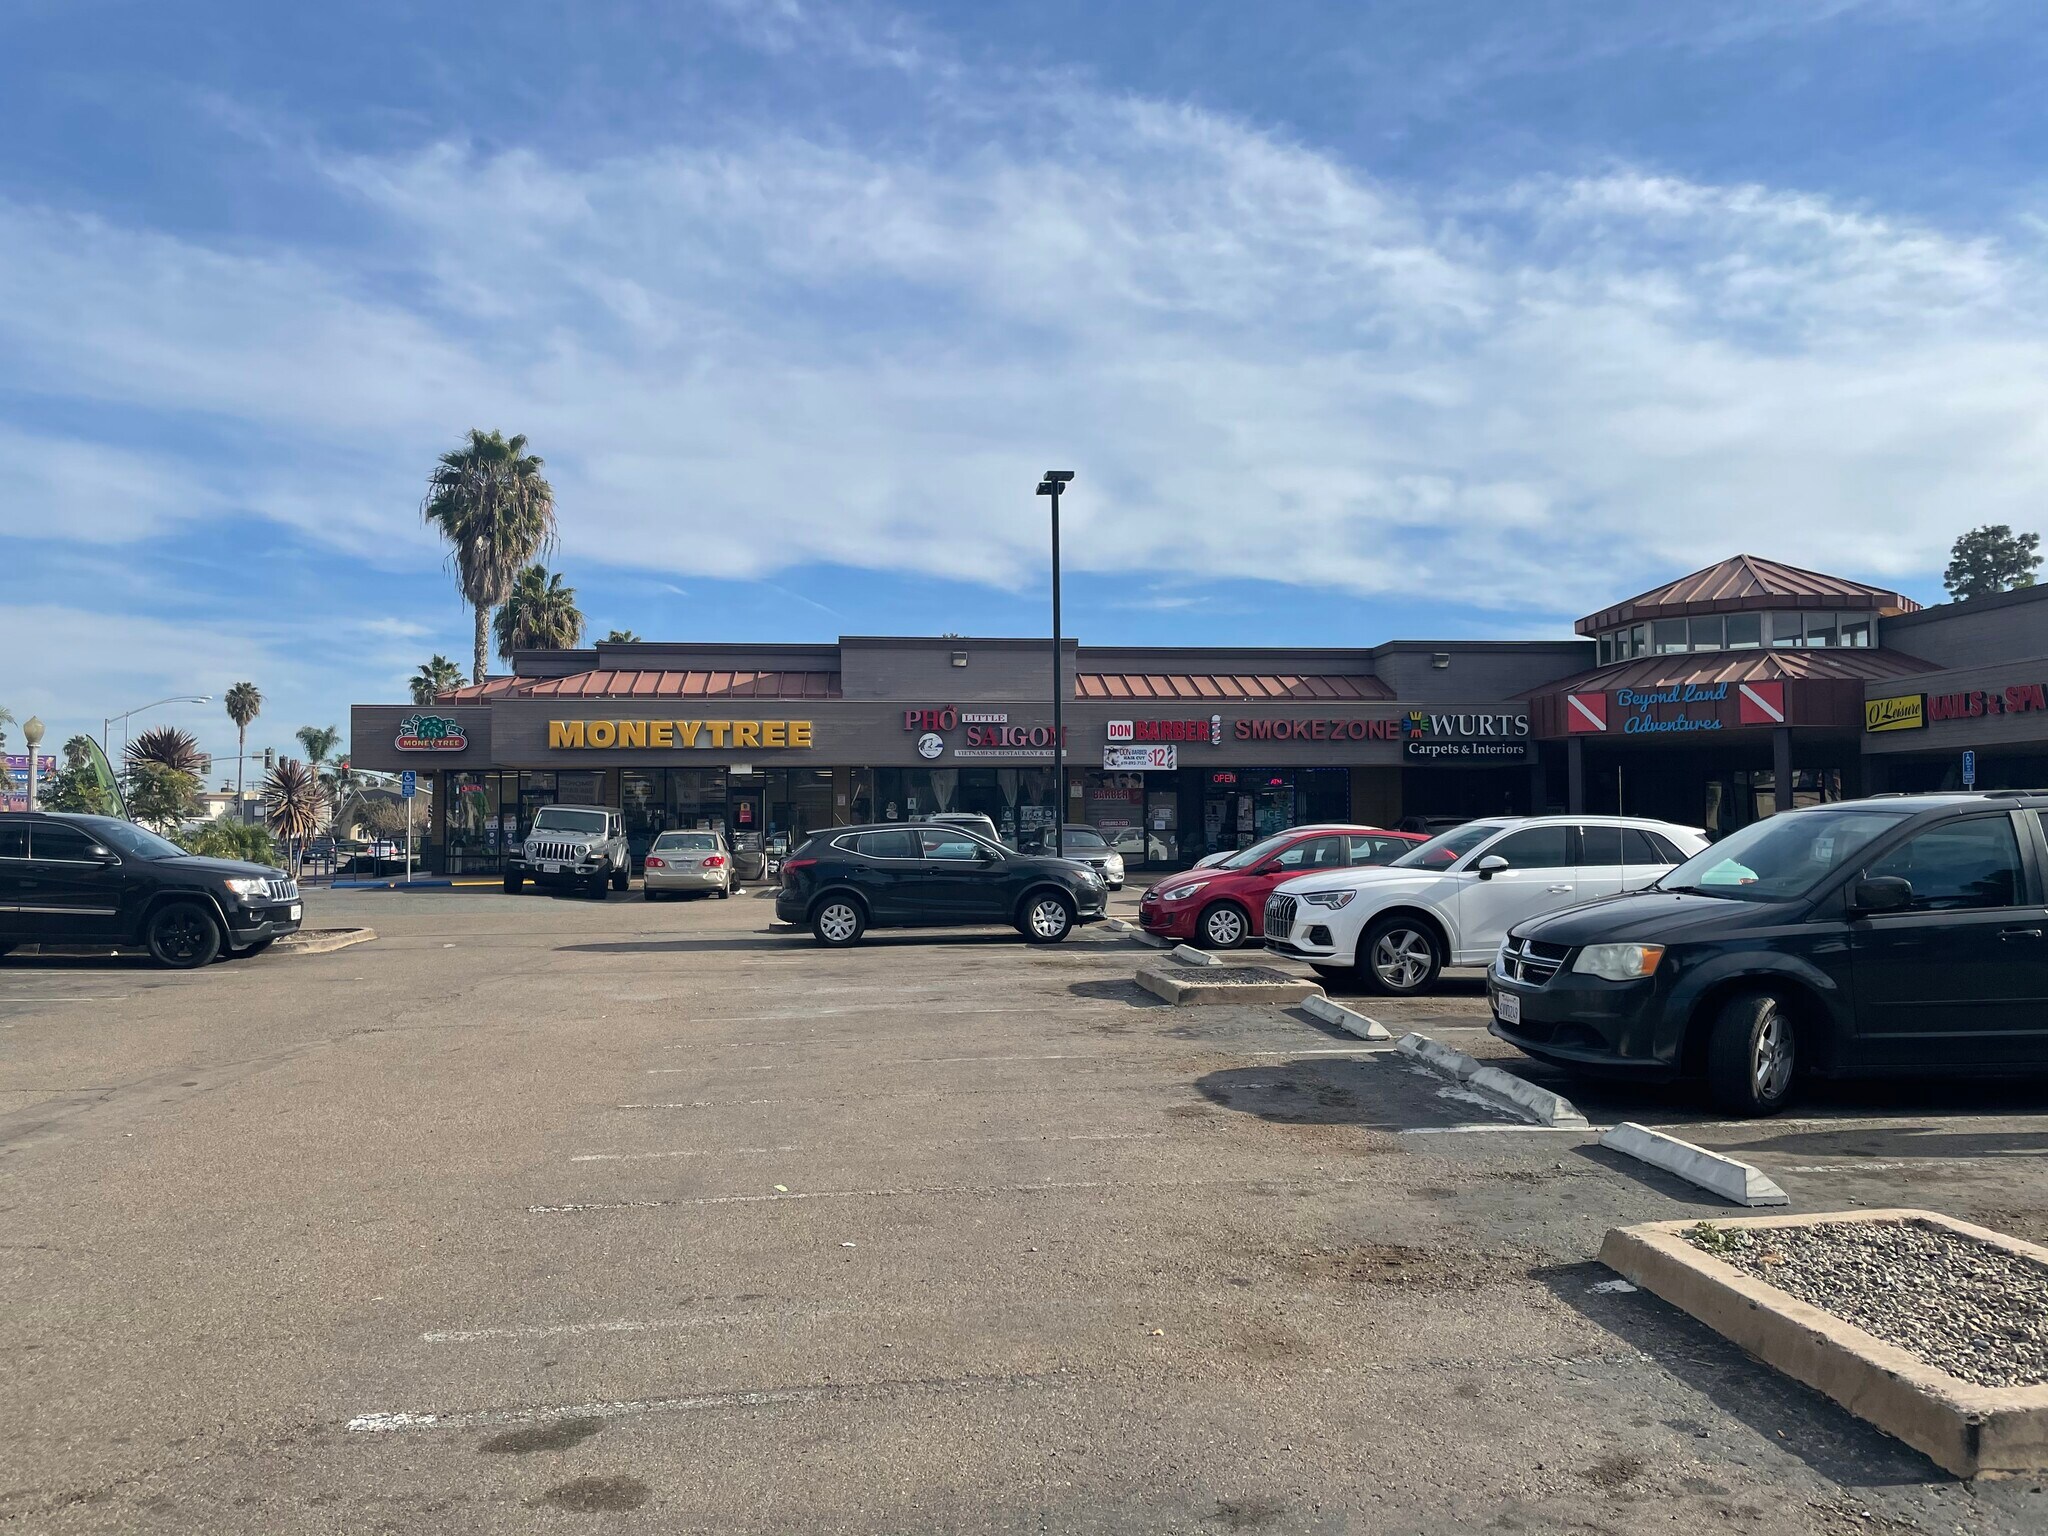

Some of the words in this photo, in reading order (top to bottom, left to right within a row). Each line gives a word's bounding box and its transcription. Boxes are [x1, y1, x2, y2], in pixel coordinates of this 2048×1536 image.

[1616, 684, 1680, 713] Beyond
[1682, 681, 1728, 702] Land
[1928, 690, 1984, 721] NAILS
[1987, 694, 2001, 714] &
[2005, 684, 2045, 713] SPA
[964, 714, 1006, 722] LITTLE
[1430, 714, 1529, 736] WURTS
[1623, 714, 1723, 734] Adventures
[549, 720, 812, 748] MONEYTREE
[1110, 725, 1131, 736] DON
[1136, 720, 1209, 740] BARBER
[1148, 748, 1166, 766] $12
[1409, 743, 1459, 757] Carpets
[1461, 745, 1470, 754] &
[1473, 743, 1524, 754] Interiors
[1213, 774, 1236, 783] OPEN
[1093, 789, 1129, 799] BARBER
[1265, 810, 1281, 818] ICE
